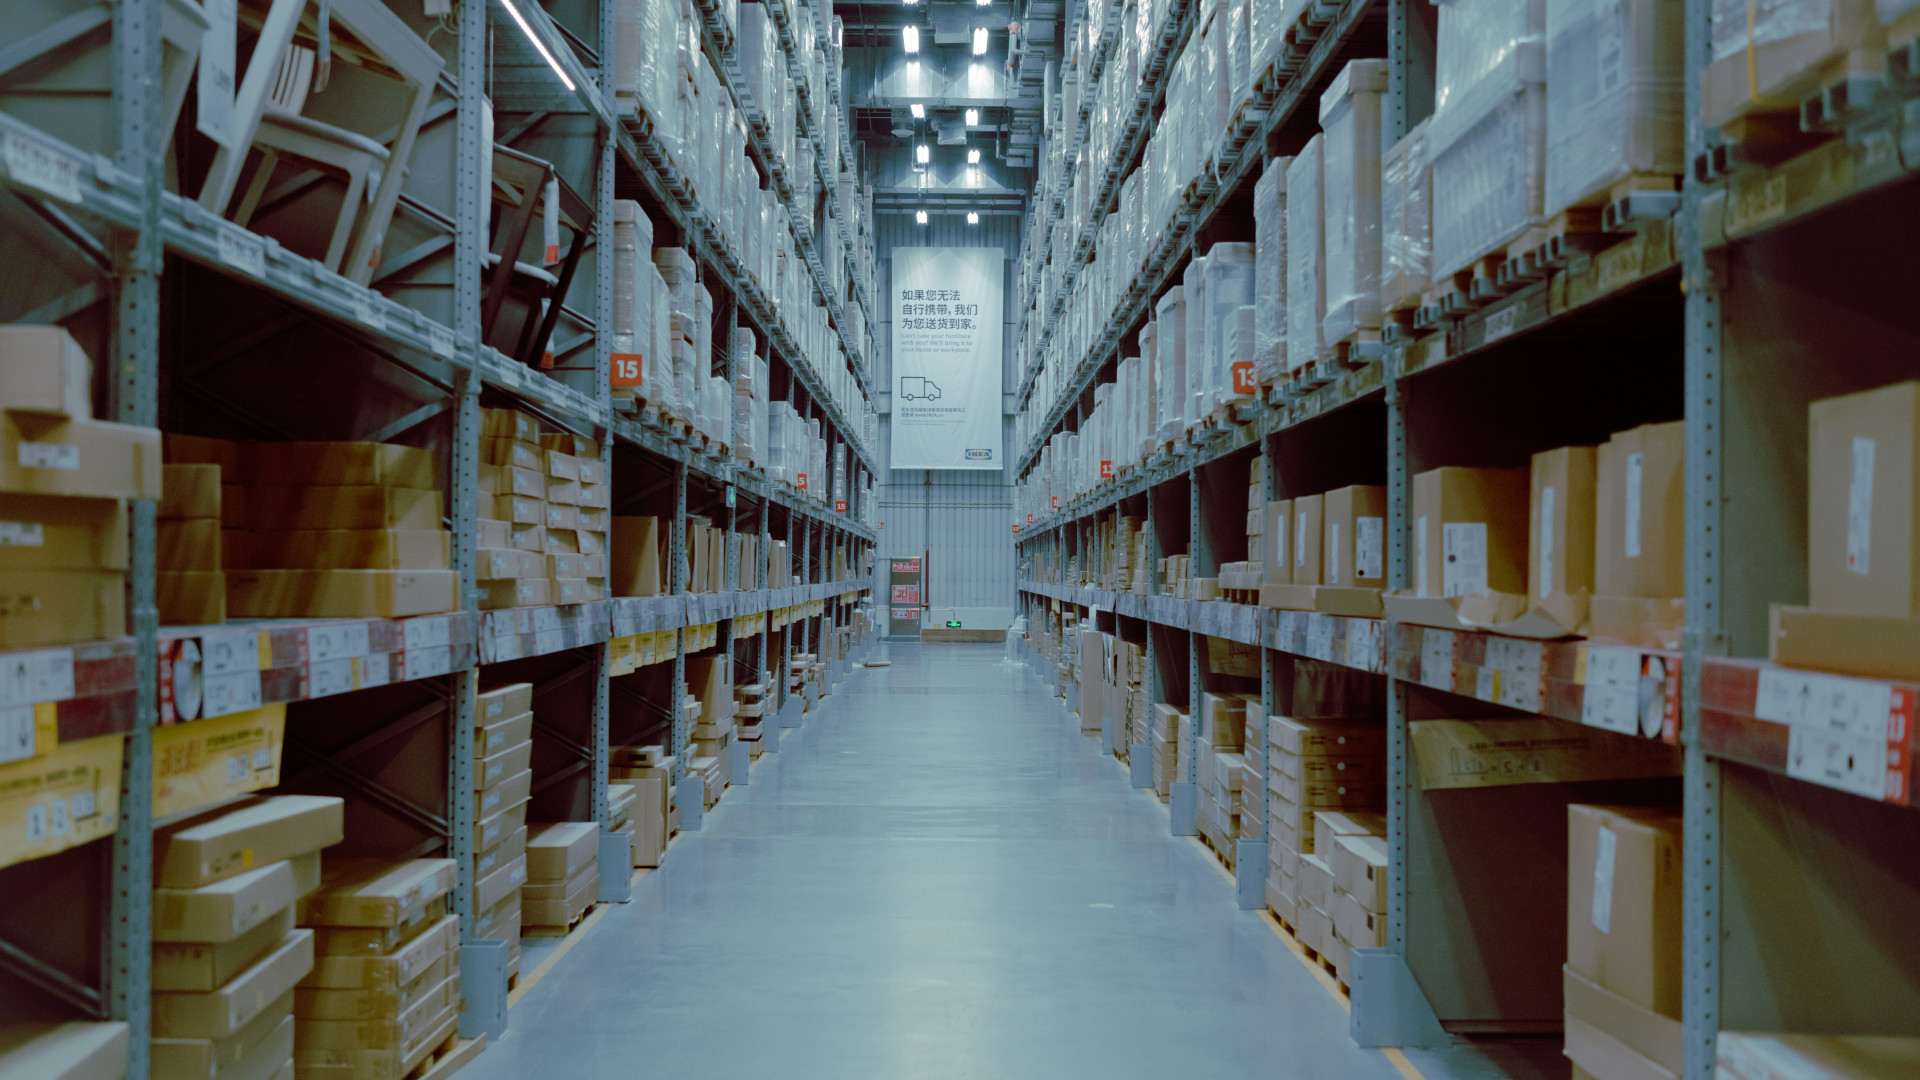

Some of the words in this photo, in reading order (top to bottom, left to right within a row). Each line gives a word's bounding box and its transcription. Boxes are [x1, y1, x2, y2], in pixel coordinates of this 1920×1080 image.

[902, 289, 961, 301] 如果您无法
[902, 317, 977, 330] 为您送货到家。
[616, 359, 639, 379] 15
[1237, 368, 1256, 387] 13
